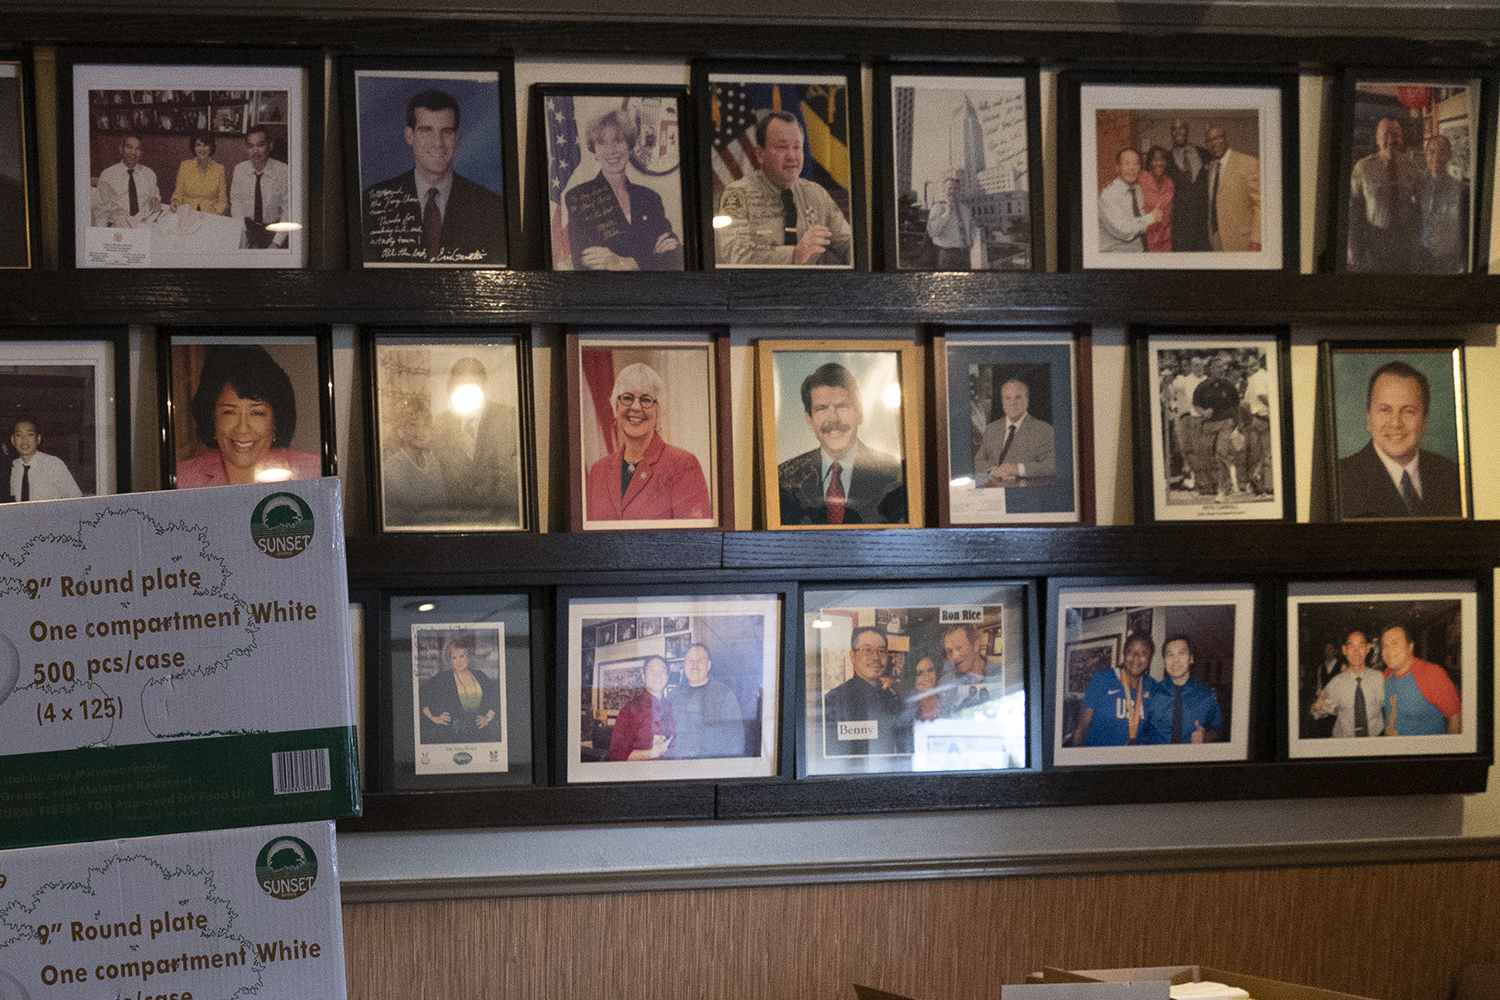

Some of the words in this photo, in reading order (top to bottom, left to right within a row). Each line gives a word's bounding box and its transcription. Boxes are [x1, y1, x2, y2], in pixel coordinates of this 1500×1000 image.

[257, 534, 311, 554] SUNSET
[61, 570, 135, 598] Round
[141, 565, 202, 595] plate
[30, 619, 78, 643] One
[85, 606, 241, 639] compartment
[249, 600, 318, 625] White
[942, 606, 960, 621] Ron
[962, 605, 982, 621] Rice
[33, 661, 75, 686] 500
[86, 649, 186, 682] pcs/case
[36, 702, 57, 727] (4
[61, 704, 74, 722] x
[79, 695, 124, 722] 125)
[839, 723, 874, 738] Benny
[262, 876, 315, 895] SUNSET
[71, 914, 143, 943] Round
[150, 910, 209, 940] plate
[40, 963, 88, 986] One
[94, 947, 247, 982] compartment
[256, 939, 322, 964] White
